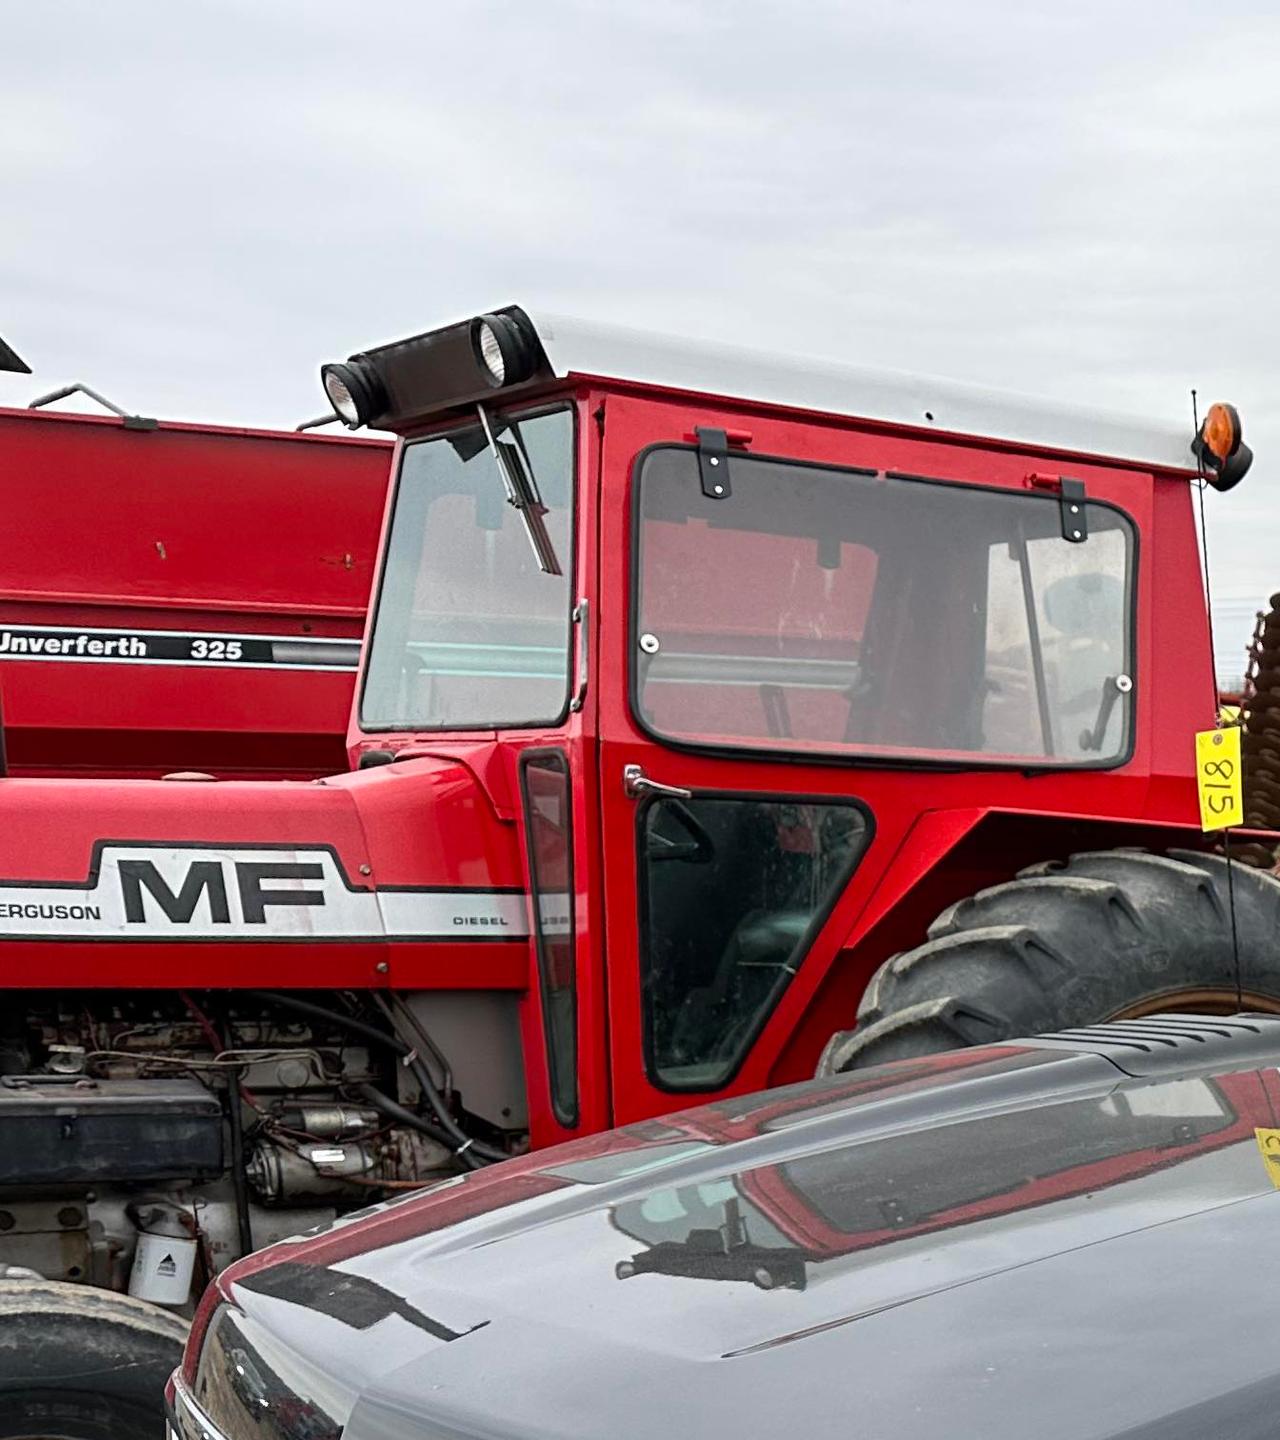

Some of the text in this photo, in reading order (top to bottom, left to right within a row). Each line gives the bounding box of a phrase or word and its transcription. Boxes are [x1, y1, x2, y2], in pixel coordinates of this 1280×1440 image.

[190, 640, 242, 660] 325
[1204, 759, 1234, 814] 815
[117, 859, 325, 924] MF
[452, 916, 508, 926] DIESEL
